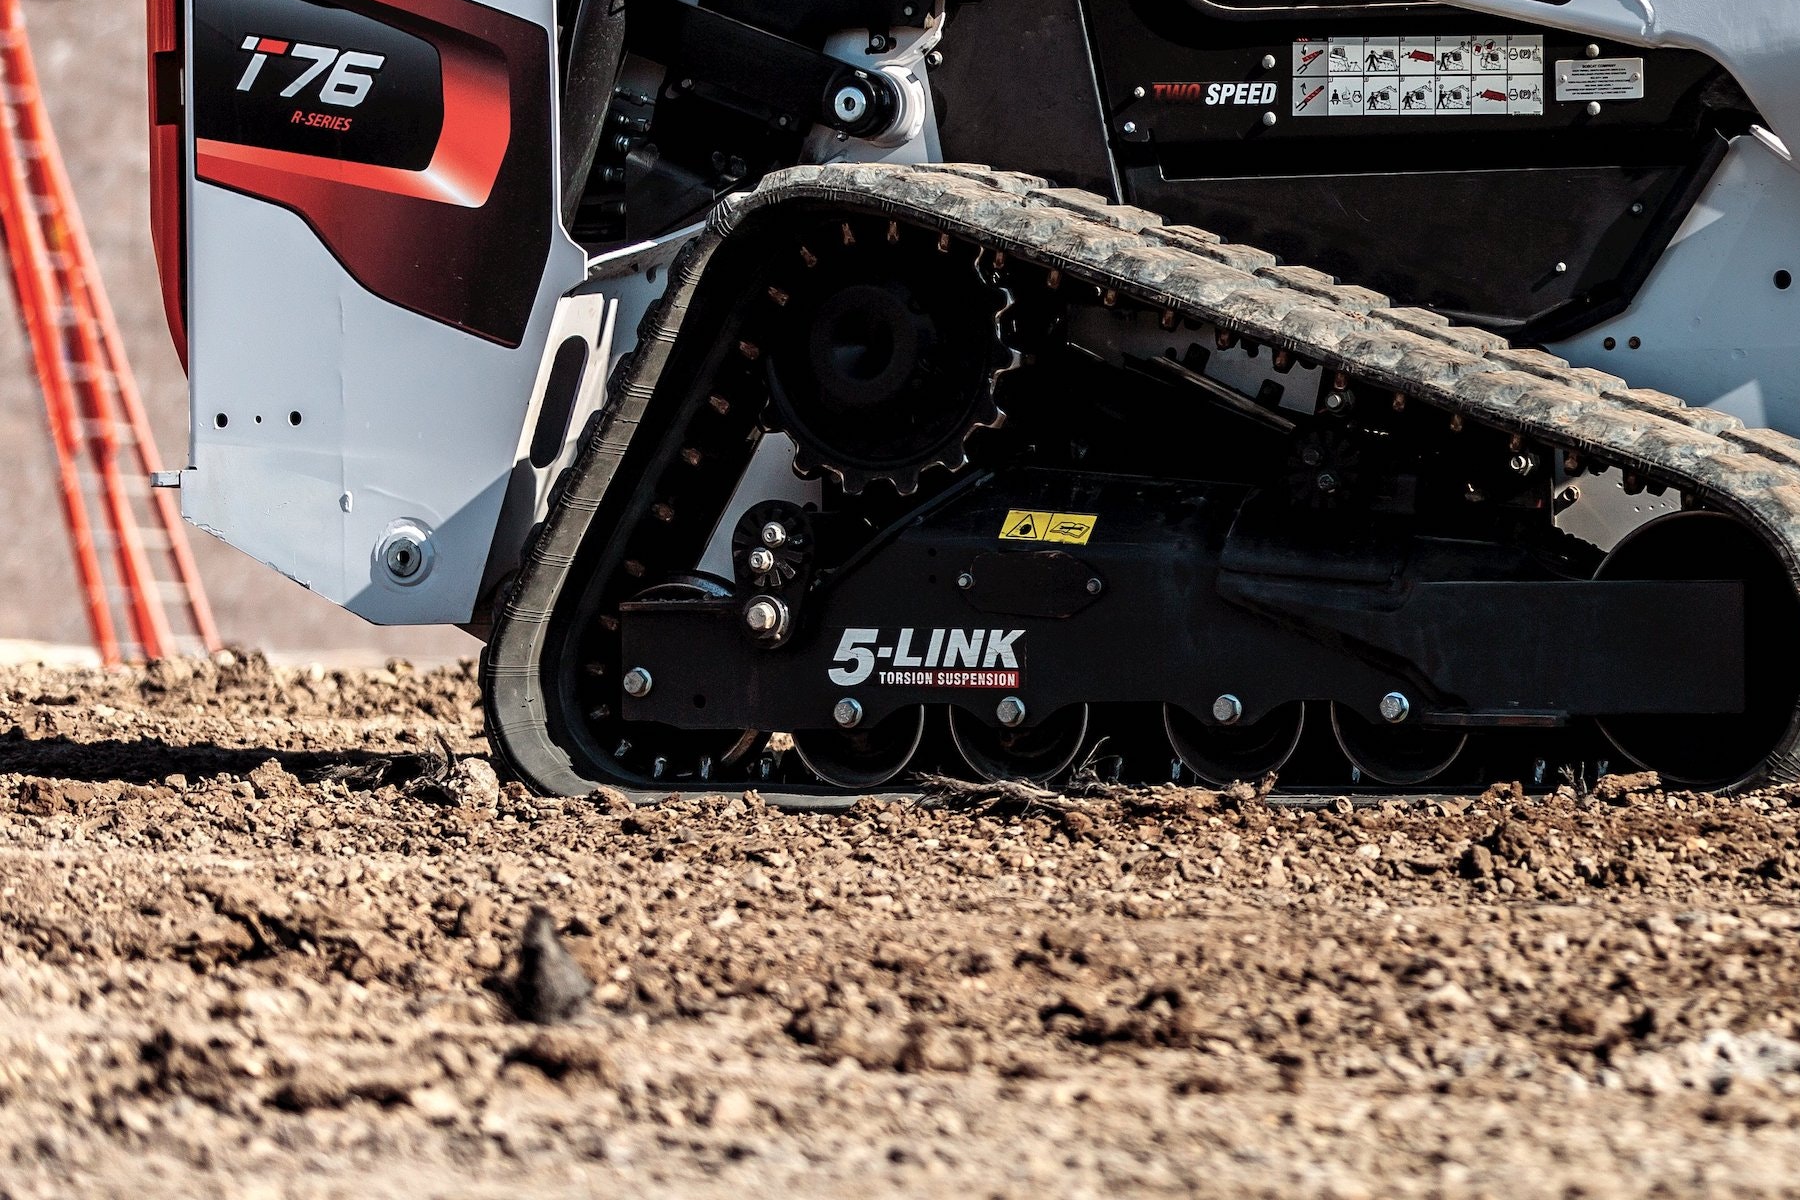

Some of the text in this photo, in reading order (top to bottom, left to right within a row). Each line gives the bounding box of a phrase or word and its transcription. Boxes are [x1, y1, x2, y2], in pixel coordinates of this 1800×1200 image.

[236, 35, 385, 108] T76
[1153, 83, 1277, 105] TWO SPEED
[291, 110, 353, 132] R-SERIES
[828, 628, 1027, 687] 5-LINK
[879, 671, 1016, 687] TORSION SUSPENSION
